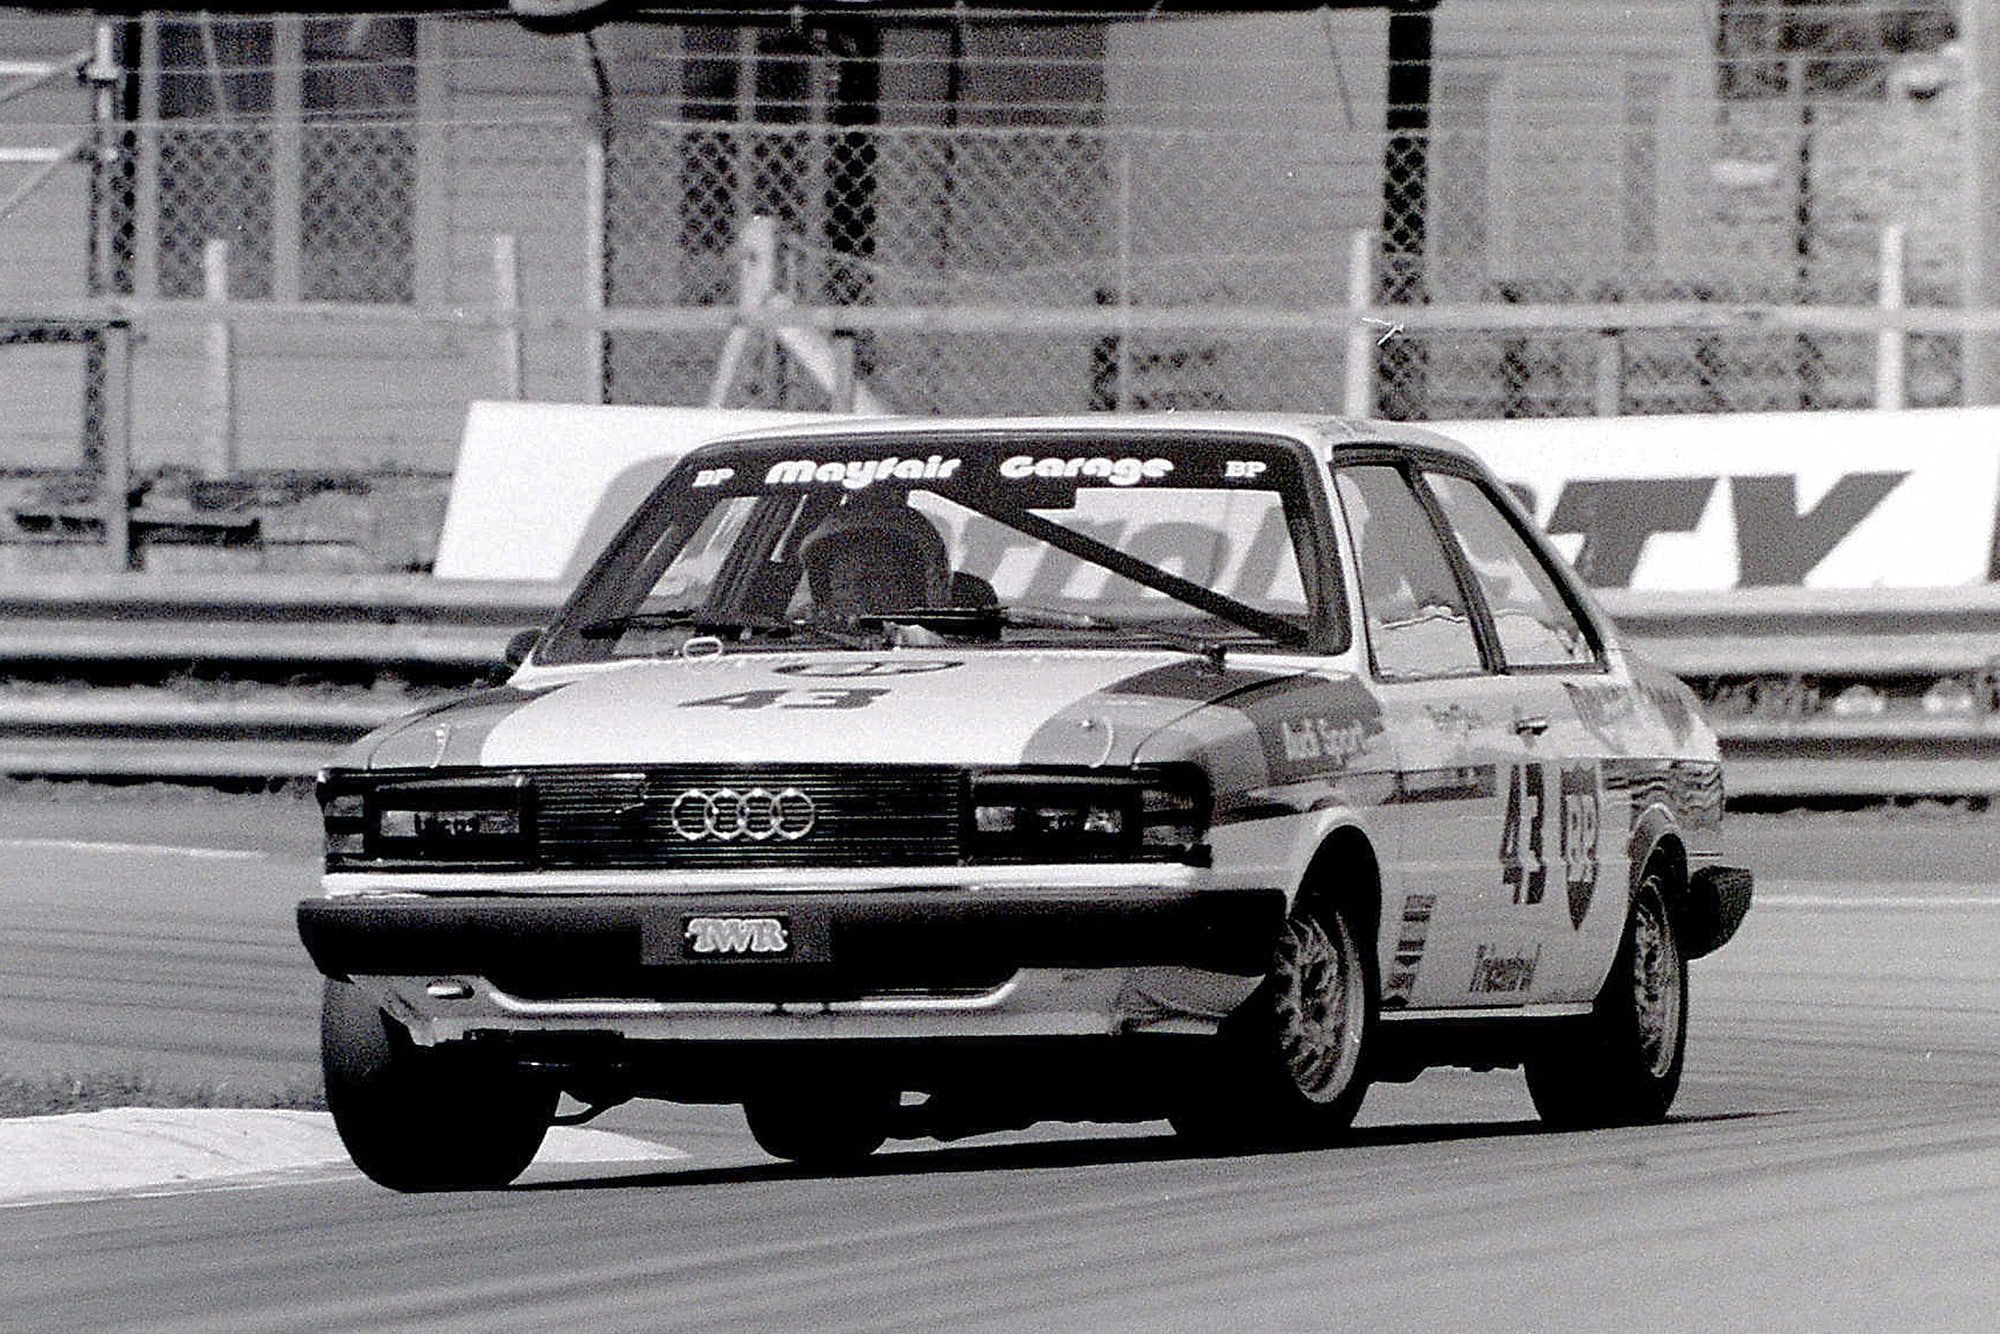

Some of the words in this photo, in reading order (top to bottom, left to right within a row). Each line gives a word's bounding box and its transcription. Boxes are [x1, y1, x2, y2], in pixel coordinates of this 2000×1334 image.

[999, 455, 1175, 487] Garage
[1223, 460, 1268, 478] BP
[677, 687, 892, 710] 43
